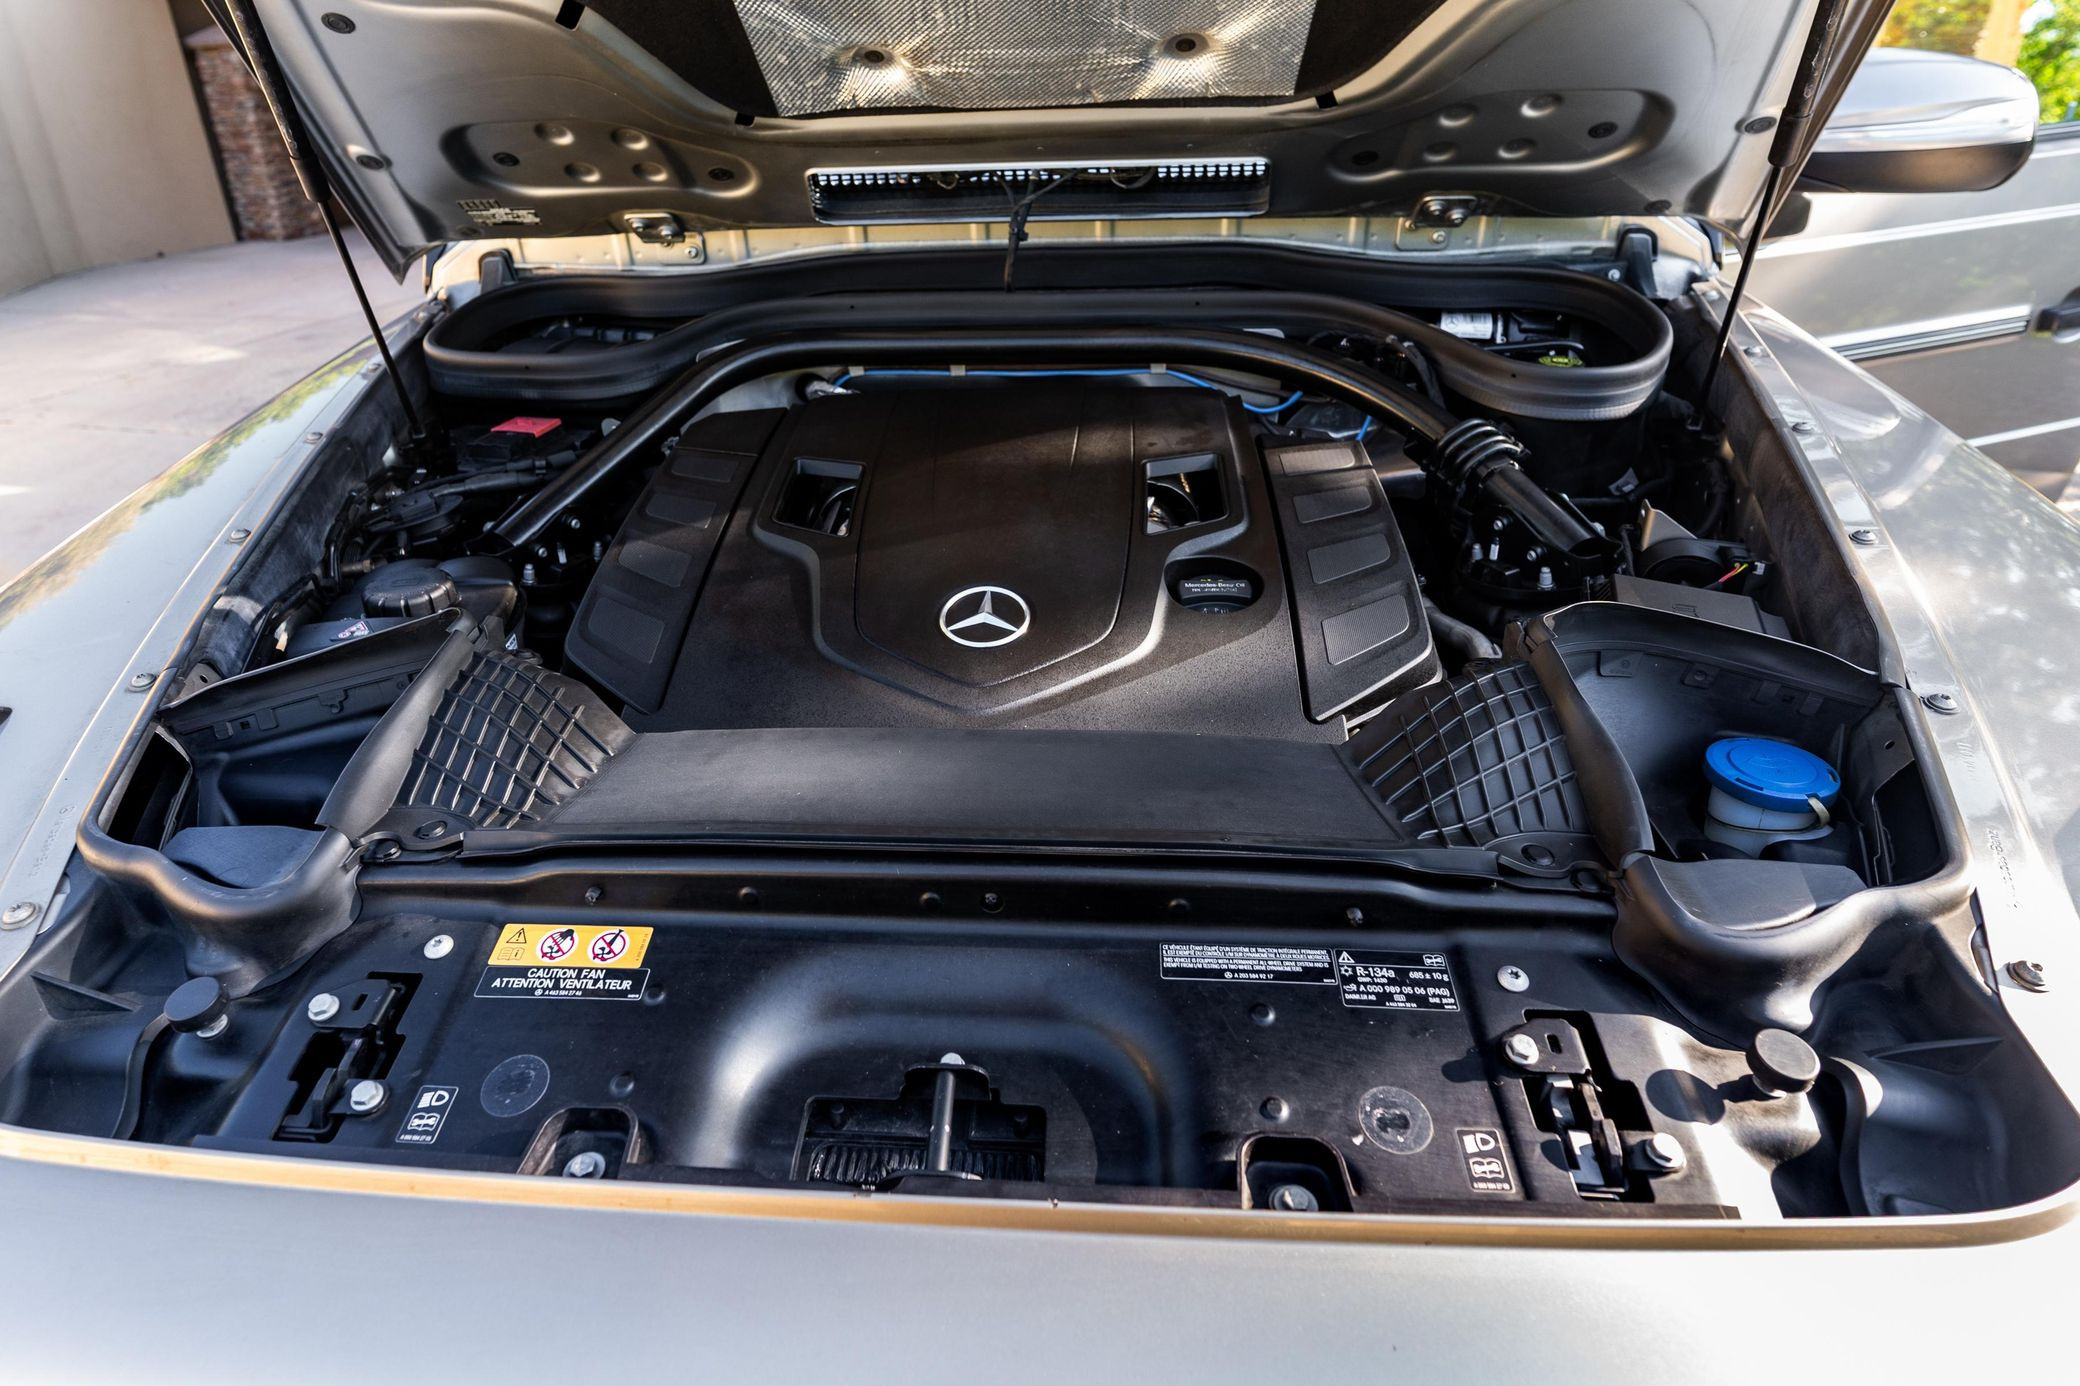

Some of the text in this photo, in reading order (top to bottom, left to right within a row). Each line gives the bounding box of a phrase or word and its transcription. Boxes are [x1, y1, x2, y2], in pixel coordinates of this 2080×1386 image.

[528, 968, 606, 978] CAUTION FAN
[1356, 966, 1395, 978] R-134a
[491, 978, 632, 990] ATTENTION VENTILATEUR
[1427, 988, 1450, 997] (PAG)
